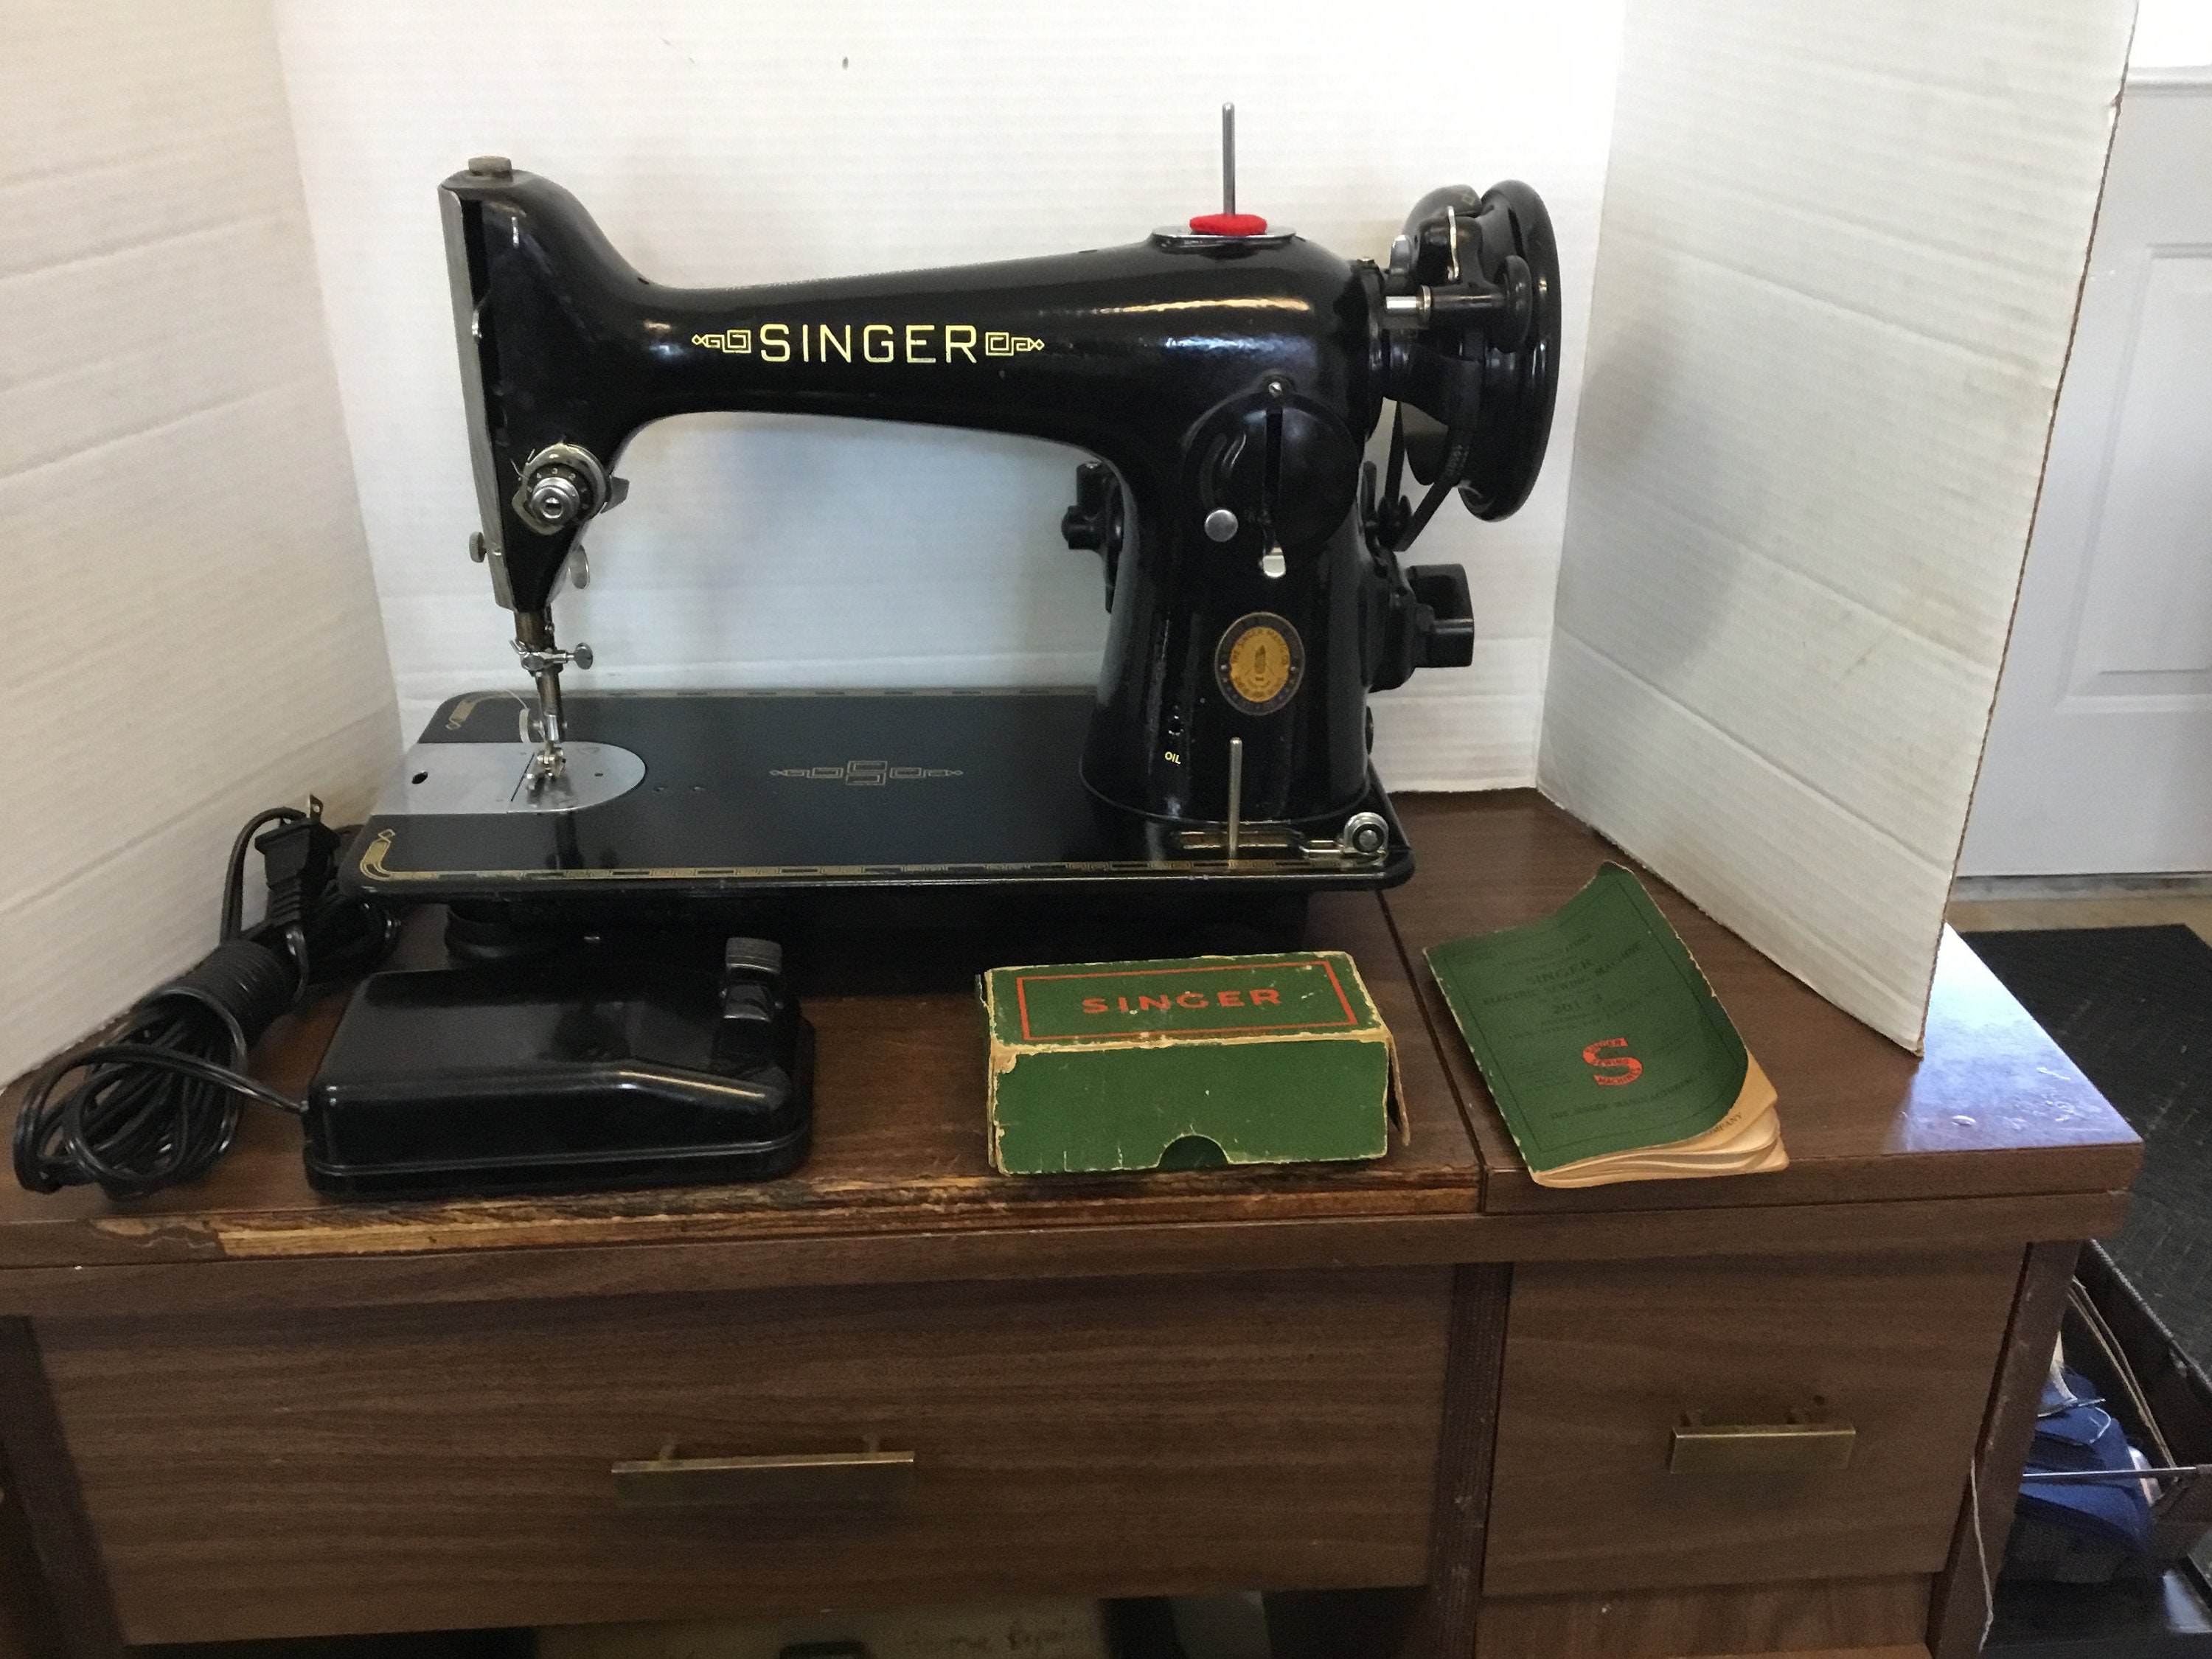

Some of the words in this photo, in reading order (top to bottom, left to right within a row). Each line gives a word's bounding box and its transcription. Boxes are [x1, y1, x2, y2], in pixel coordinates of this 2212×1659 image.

[760, 324, 978, 363] SINGER
[568, 473, 576, 481] 2
[1164, 751, 1181, 765] OIL
[1082, 989, 1281, 1014] SINGER
[1582, 1037, 1643, 1085] S
